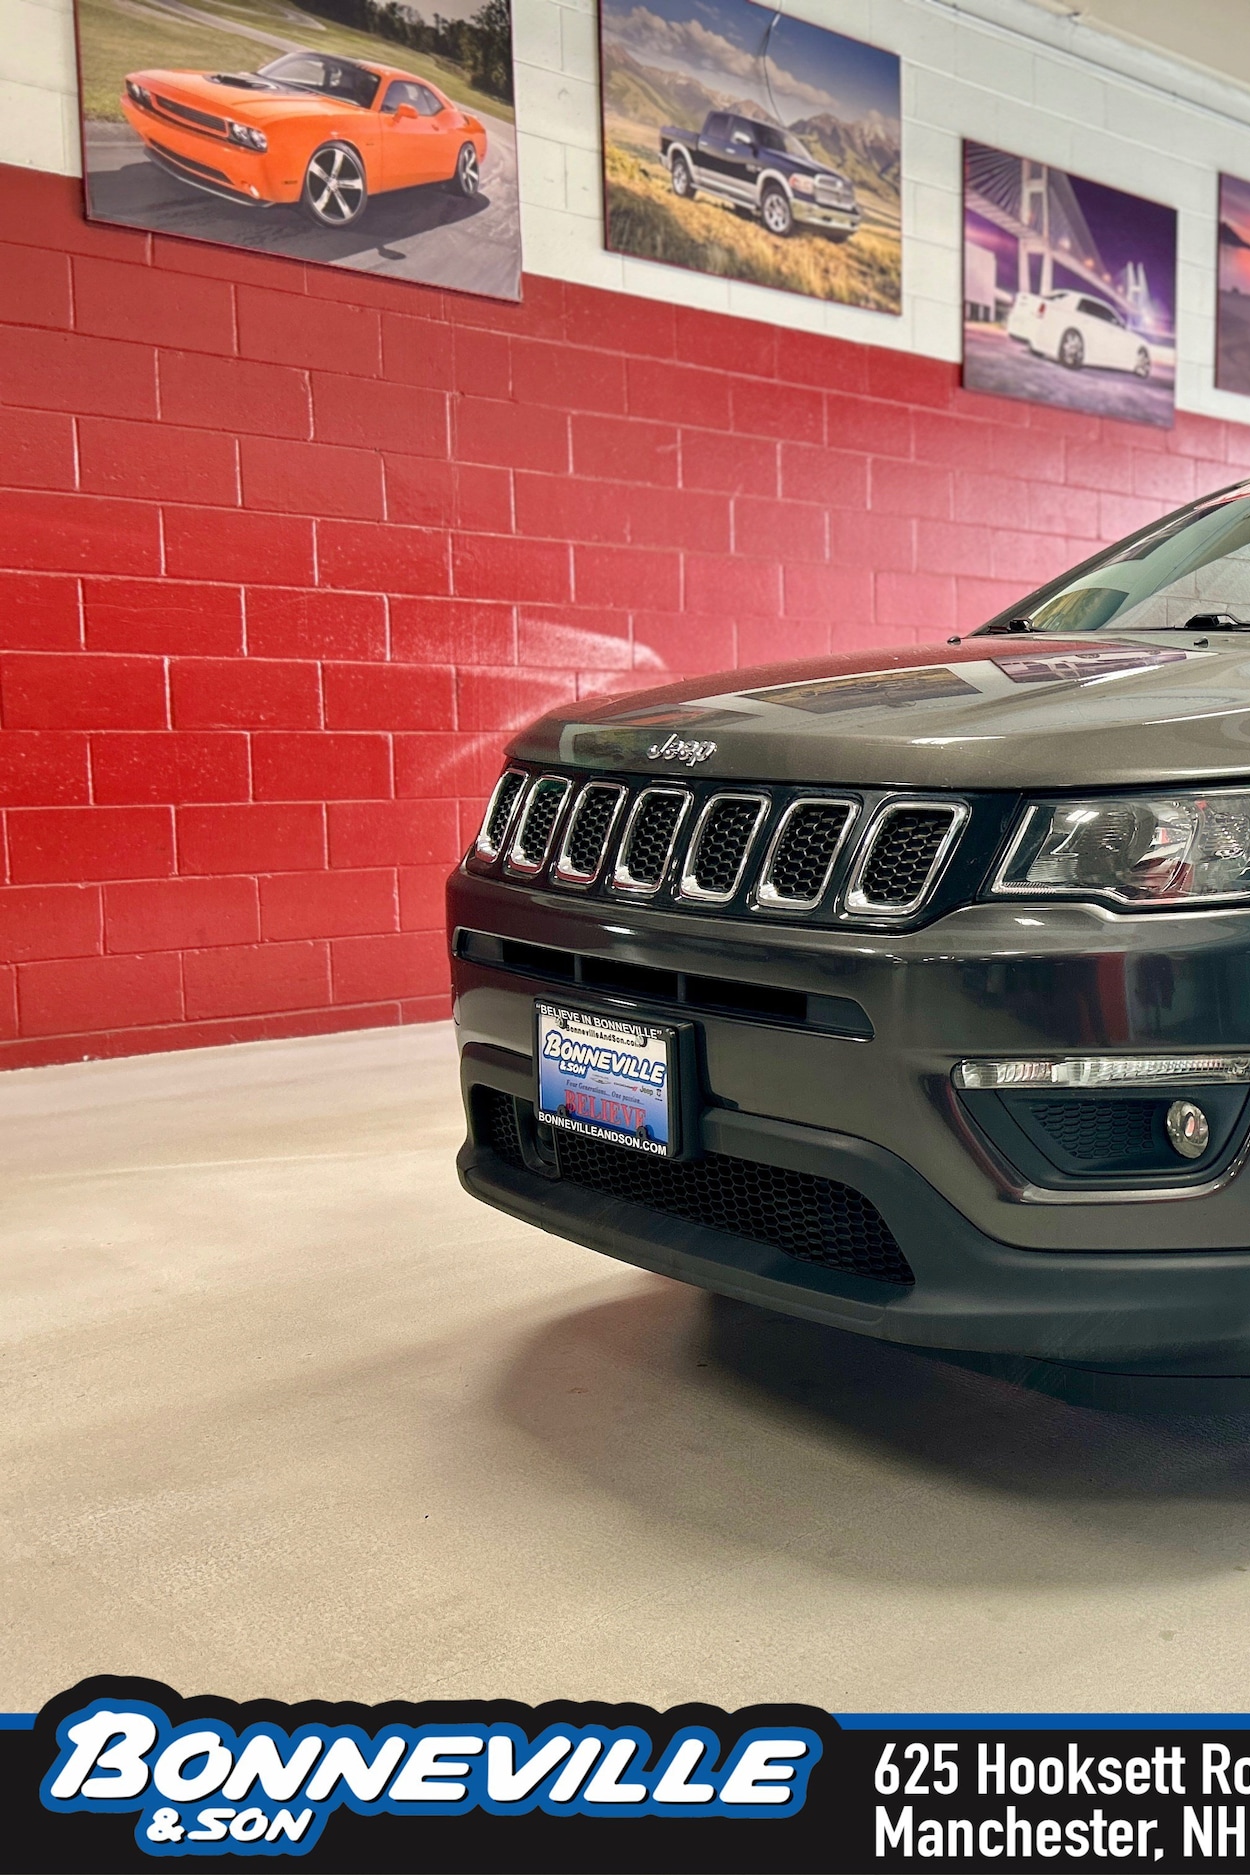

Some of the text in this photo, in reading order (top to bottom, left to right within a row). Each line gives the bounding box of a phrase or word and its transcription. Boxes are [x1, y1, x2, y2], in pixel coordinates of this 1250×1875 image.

[647, 733, 717, 767] Jeep
[581, 1015, 592, 1025] IN
[544, 1032, 665, 1084] BONNEVILLE
[538, 1110, 668, 1157] BONNEVILLEANDSON.COM
